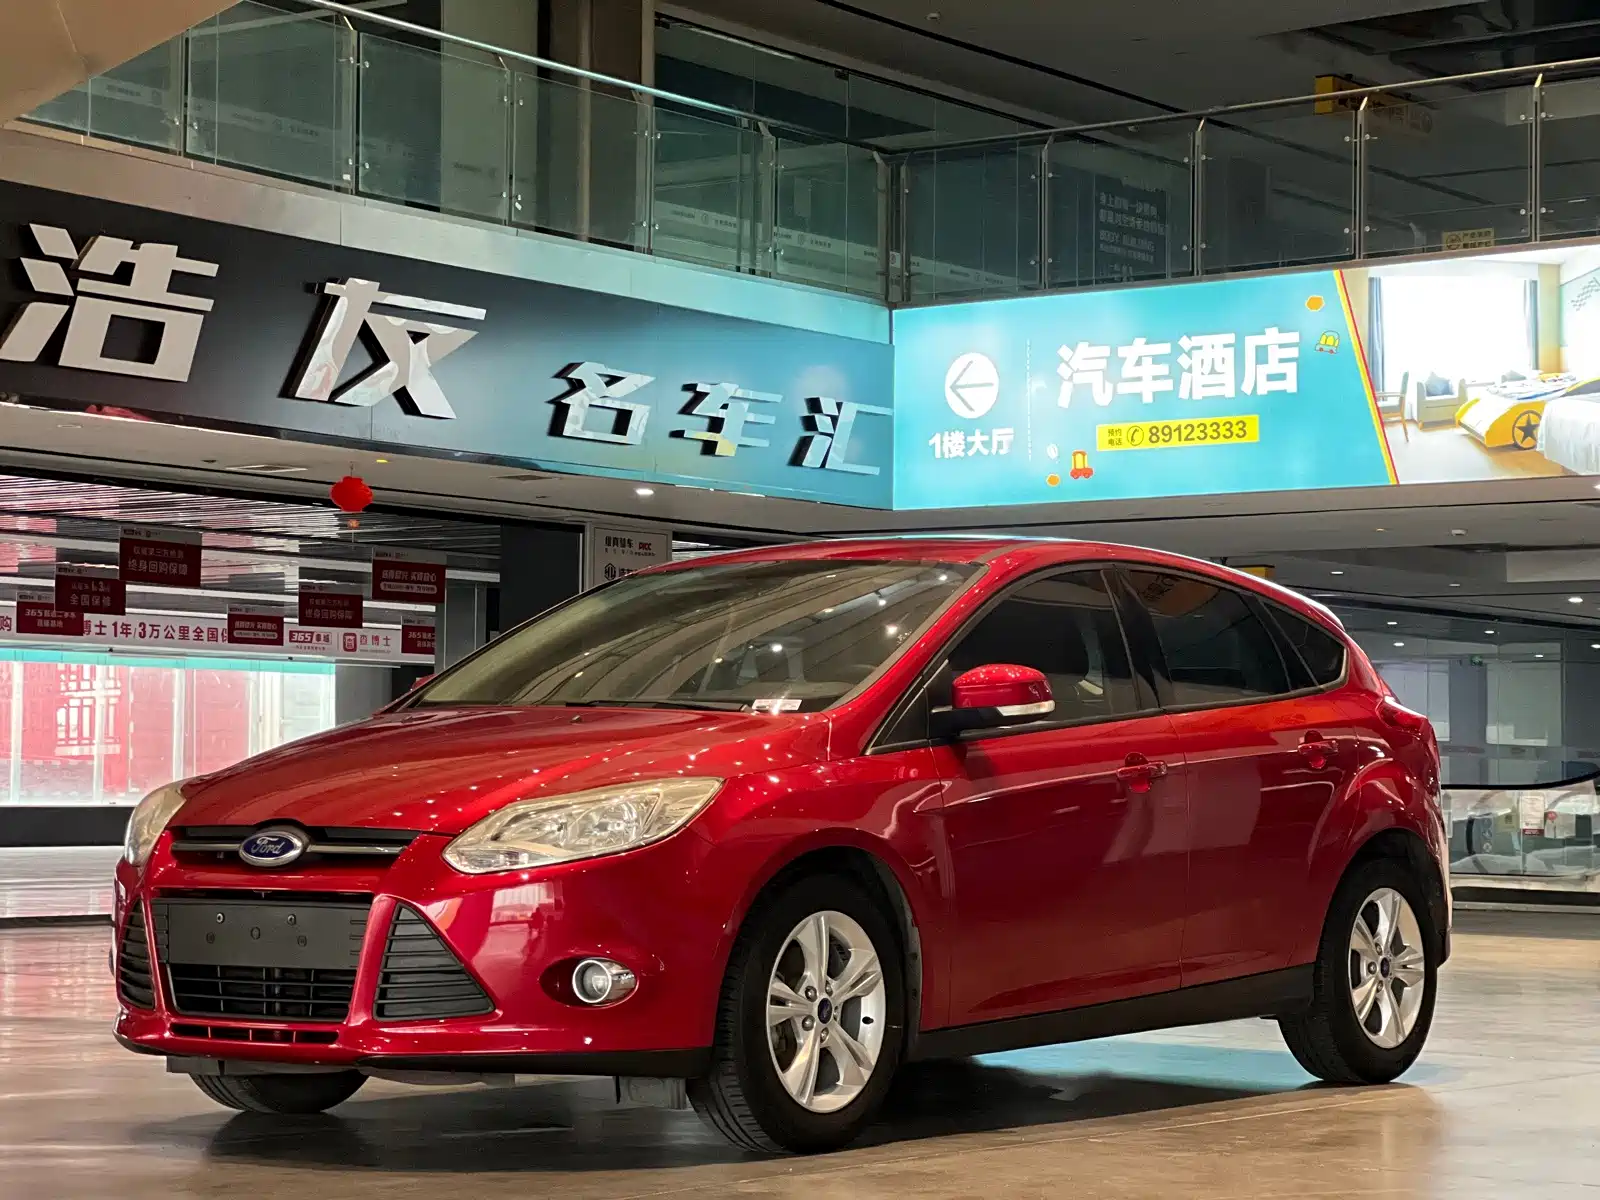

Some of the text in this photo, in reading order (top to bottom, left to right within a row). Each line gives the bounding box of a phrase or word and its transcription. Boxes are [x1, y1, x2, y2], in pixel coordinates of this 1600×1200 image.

[1057, 327, 1300, 408] 汽车酒店
[1108, 428, 1122, 437] 预约
[1108, 438, 1122, 446] 电话
[1148, 420, 1247, 444] 89123333
[928, 427, 1014, 459] 1楼大厅
[251, 836, 286, 855] Ford
